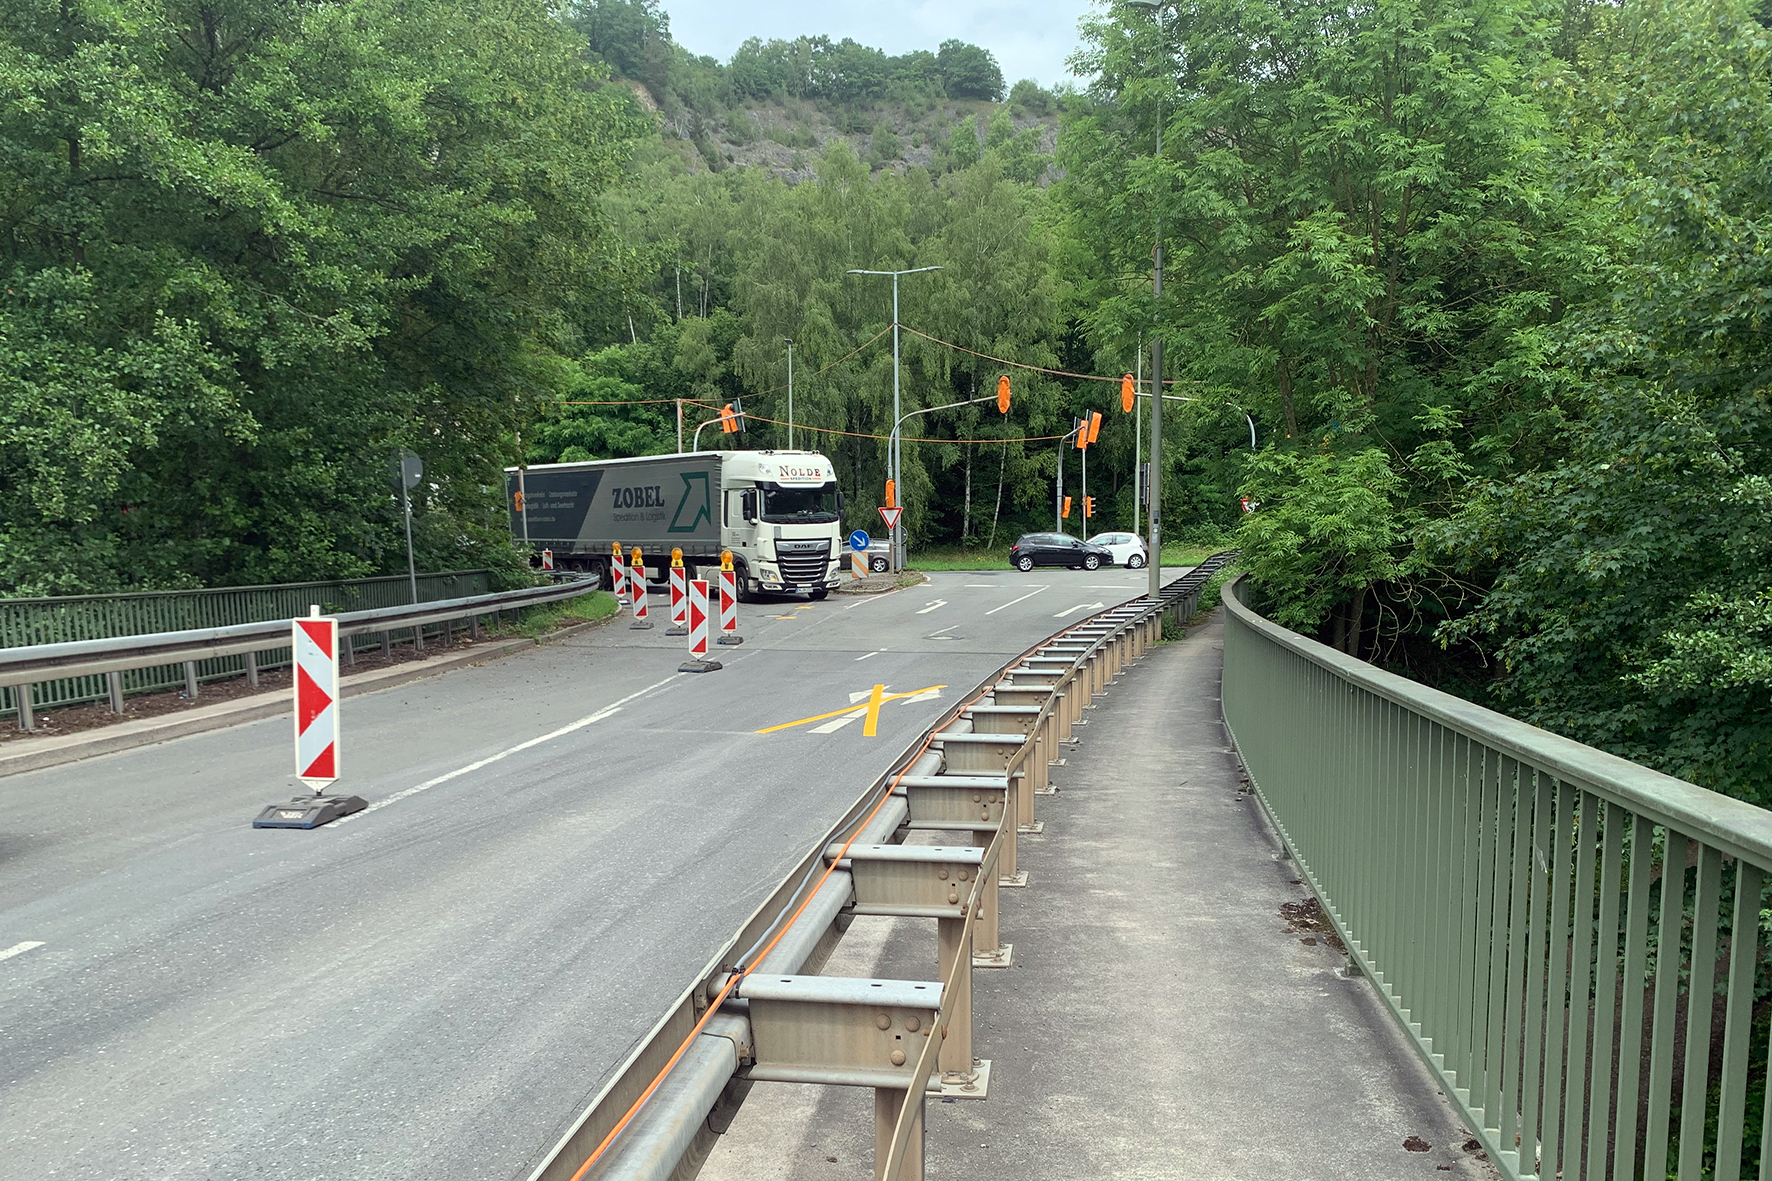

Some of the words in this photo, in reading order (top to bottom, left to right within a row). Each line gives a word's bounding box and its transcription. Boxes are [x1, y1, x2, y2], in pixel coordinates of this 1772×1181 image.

[612, 486, 665, 508] ZOBEL
[613, 512, 639, 523] Spedition
[646, 512, 666, 522] Logistik
